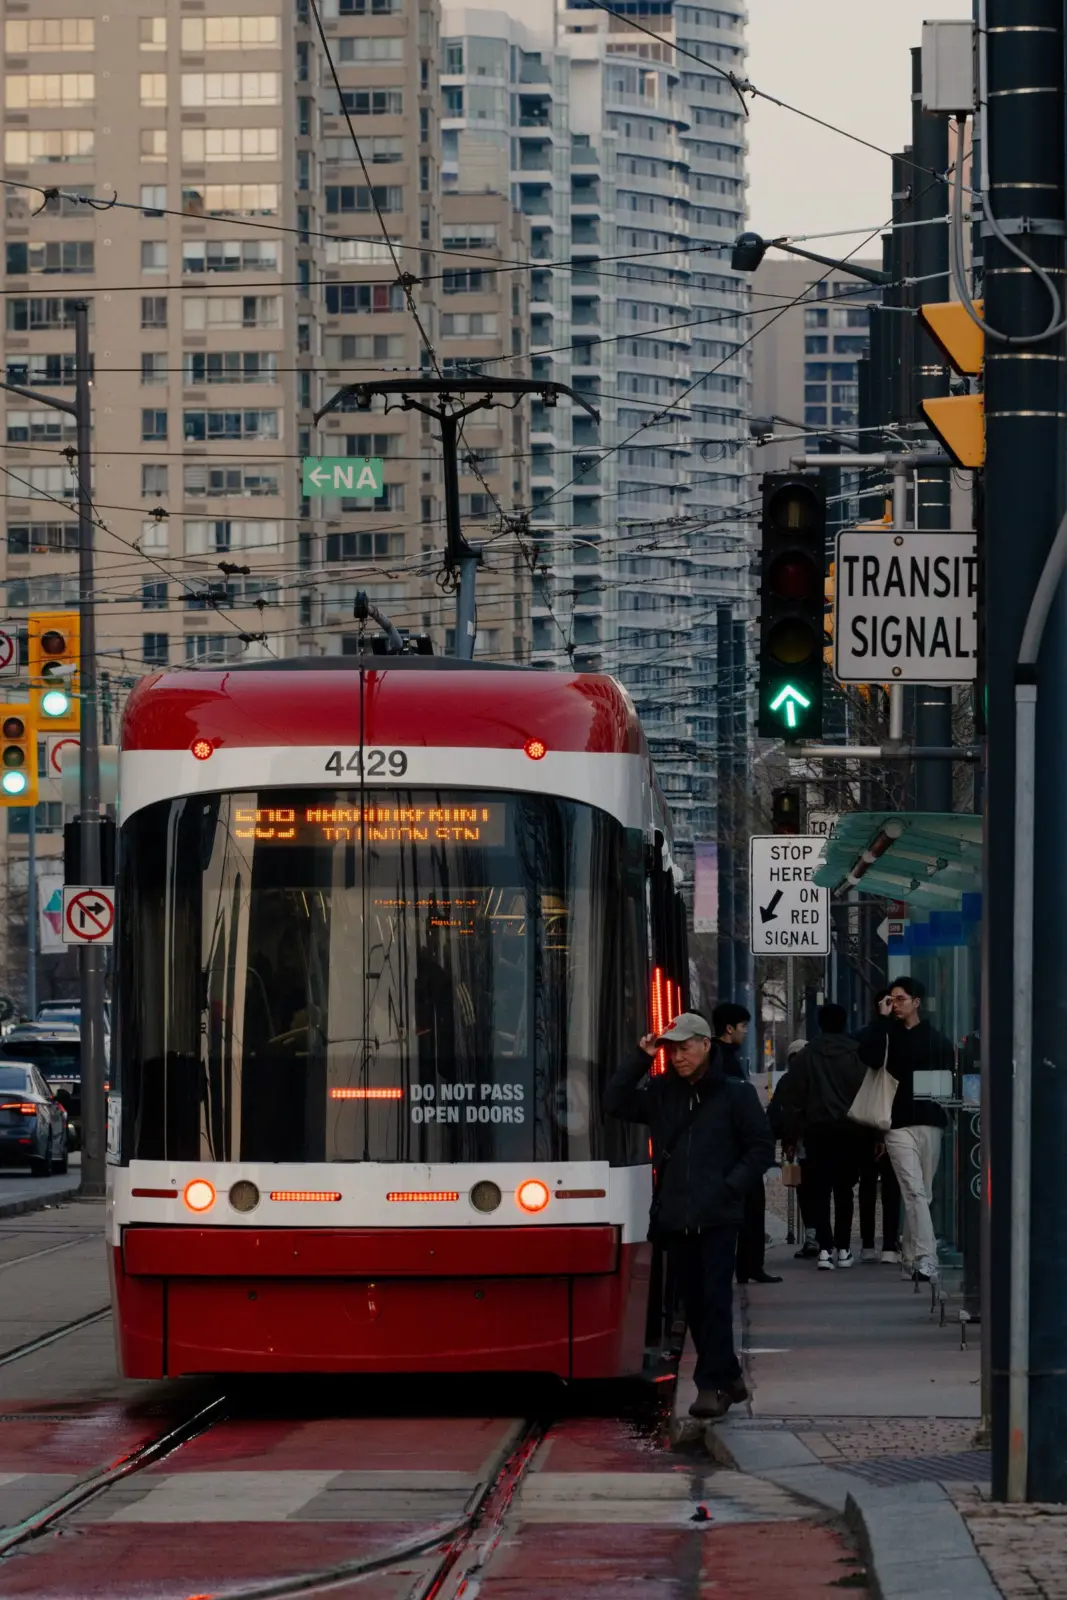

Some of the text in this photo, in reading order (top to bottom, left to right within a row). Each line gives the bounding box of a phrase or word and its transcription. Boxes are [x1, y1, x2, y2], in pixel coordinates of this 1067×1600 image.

[333, 465, 378, 489] NA
[843, 555, 978, 598] TRANSIT
[851, 615, 970, 658] SIGNAL
[325, 749, 408, 777] 4429
[771, 846, 813, 860] STOP
[770, 867, 813, 882] HERE
[800, 889, 819, 903] ON
[791, 910, 819, 924] RED
[765, 931, 819, 946] SIGNAL
[410, 1084, 524, 1101] DO NOT PASS
[411, 1106, 525, 1123] OPEN DOORS
